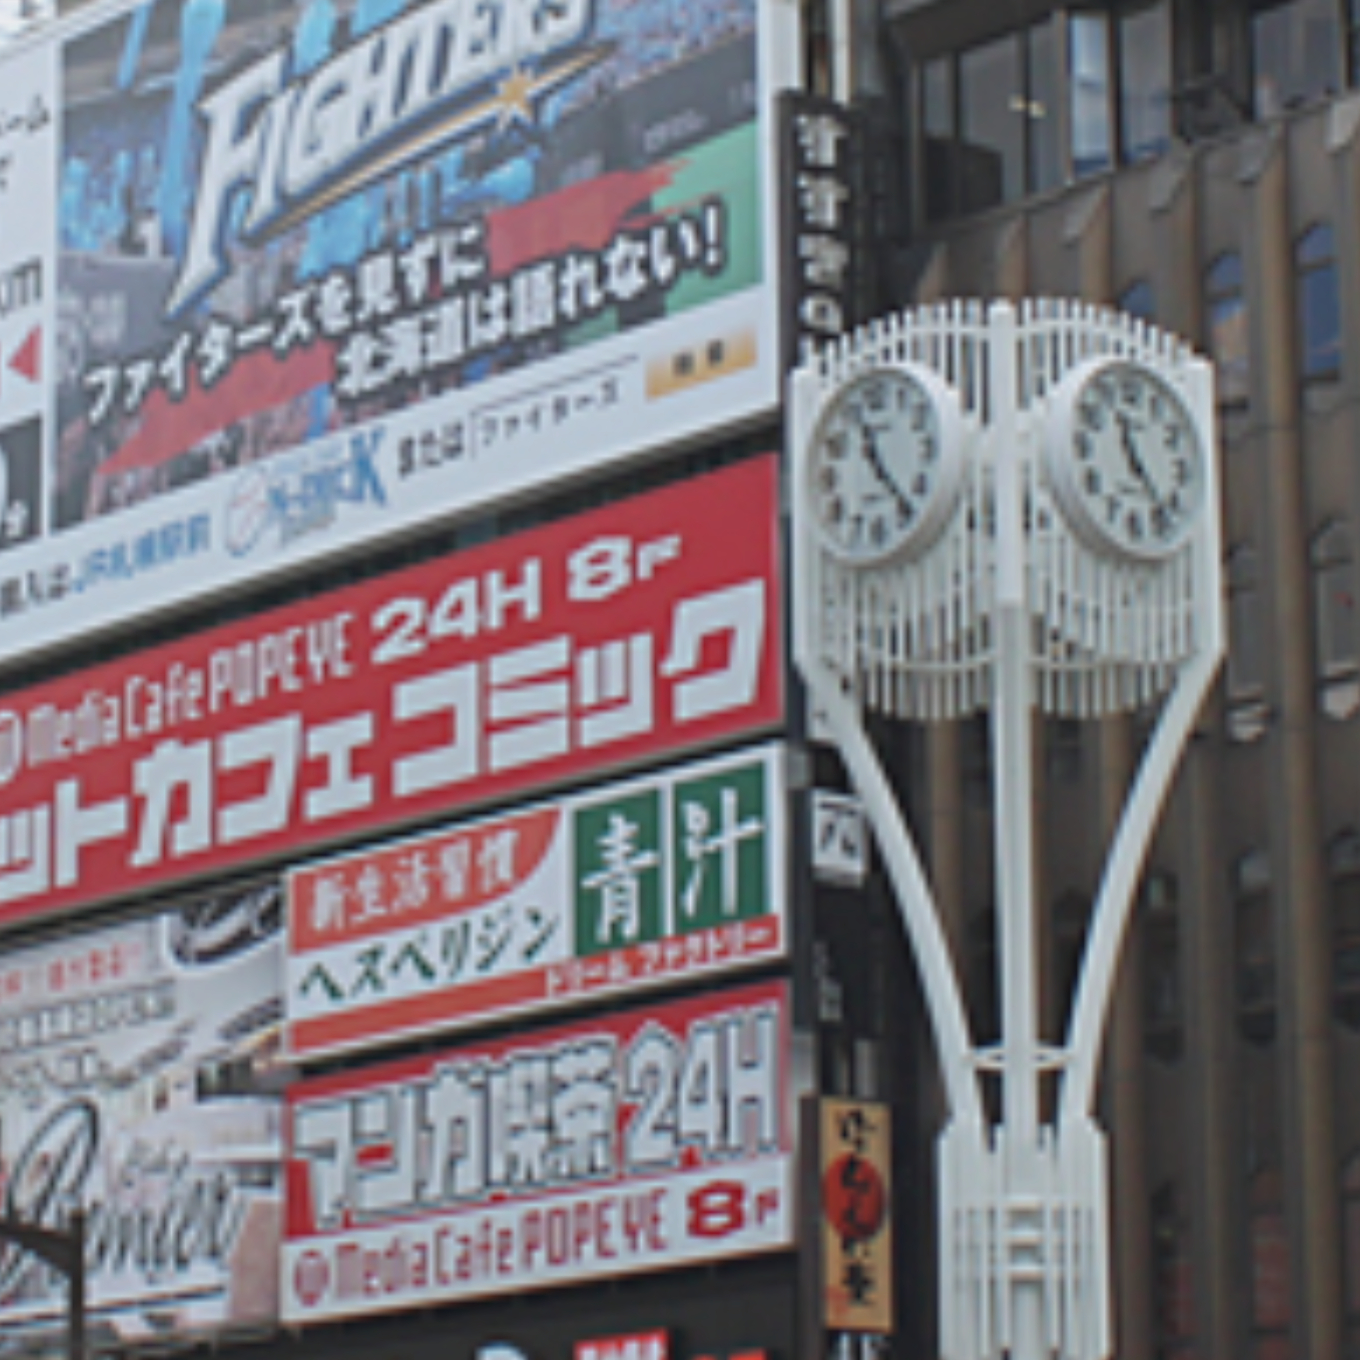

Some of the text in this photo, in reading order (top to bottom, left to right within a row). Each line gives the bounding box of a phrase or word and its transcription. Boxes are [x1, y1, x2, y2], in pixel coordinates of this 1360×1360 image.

[82, 223, 486, 426] ファイターズを見ずに
[24, 695, 122, 769] Media
[125, 663, 206, 736] Cafe
[209, 610, 358, 714] POPEYE
[370, 555, 542, 665] 24H
[581, 787, 764, 943] 青汁
[520, 1187, 671, 1275] POPEYE
